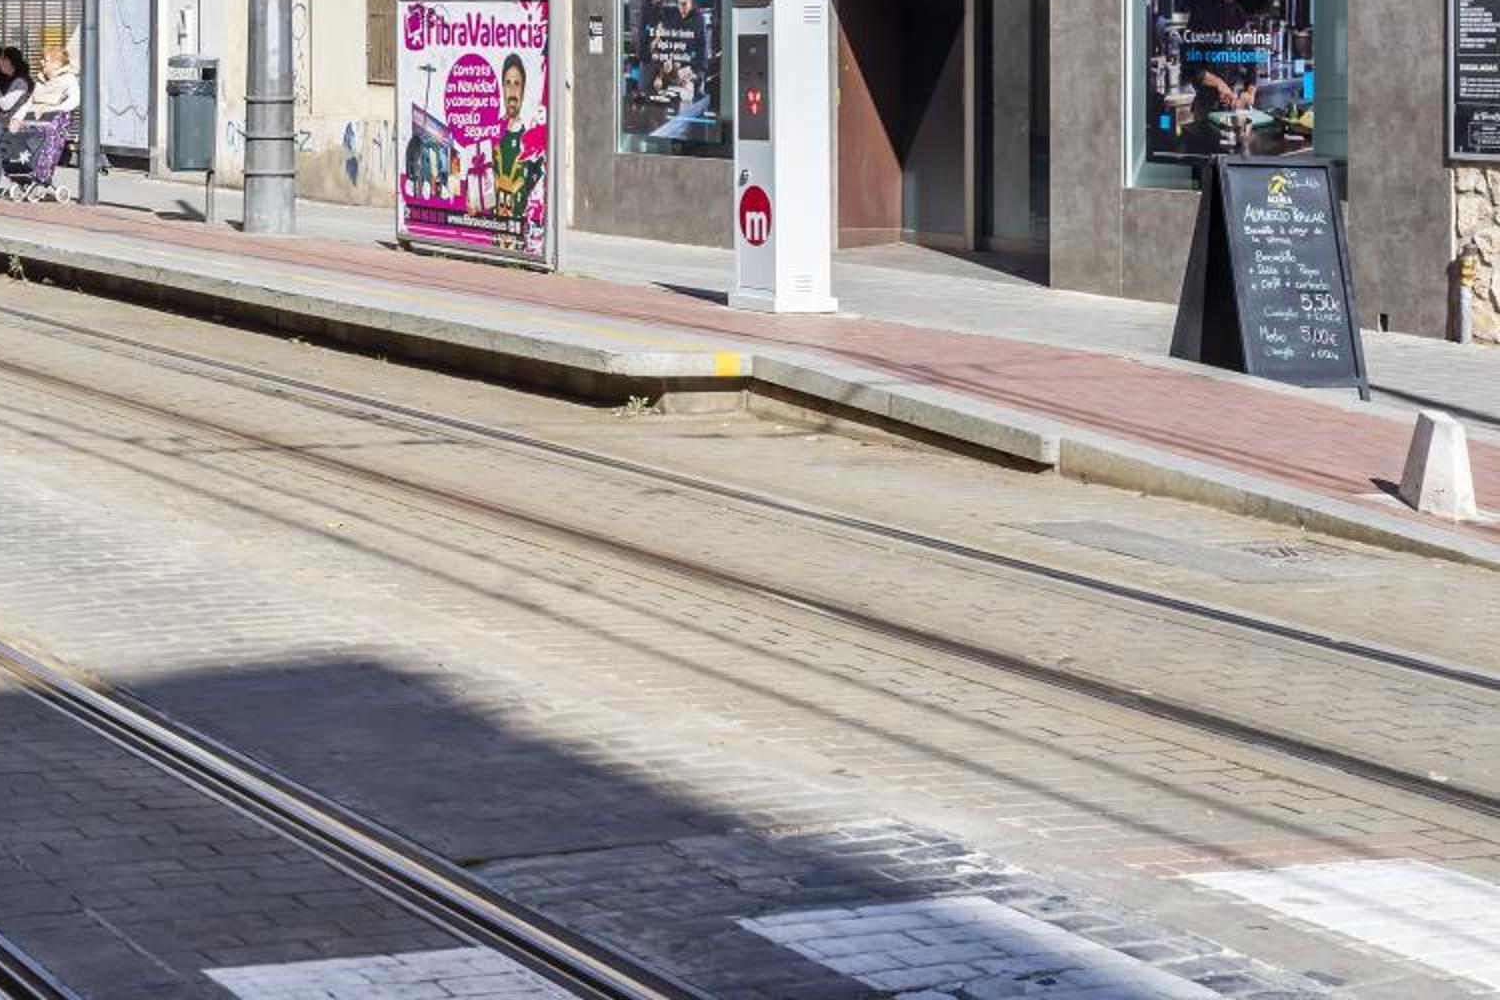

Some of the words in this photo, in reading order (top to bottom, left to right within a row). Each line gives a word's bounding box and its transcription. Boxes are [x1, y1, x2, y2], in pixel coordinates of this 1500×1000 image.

[426, 8, 544, 49] FibraValencia
[1183, 29, 1222, 44] Cuenta
[1227, 29, 1272, 45] Nómina
[457, 79, 497, 94] Navidad
